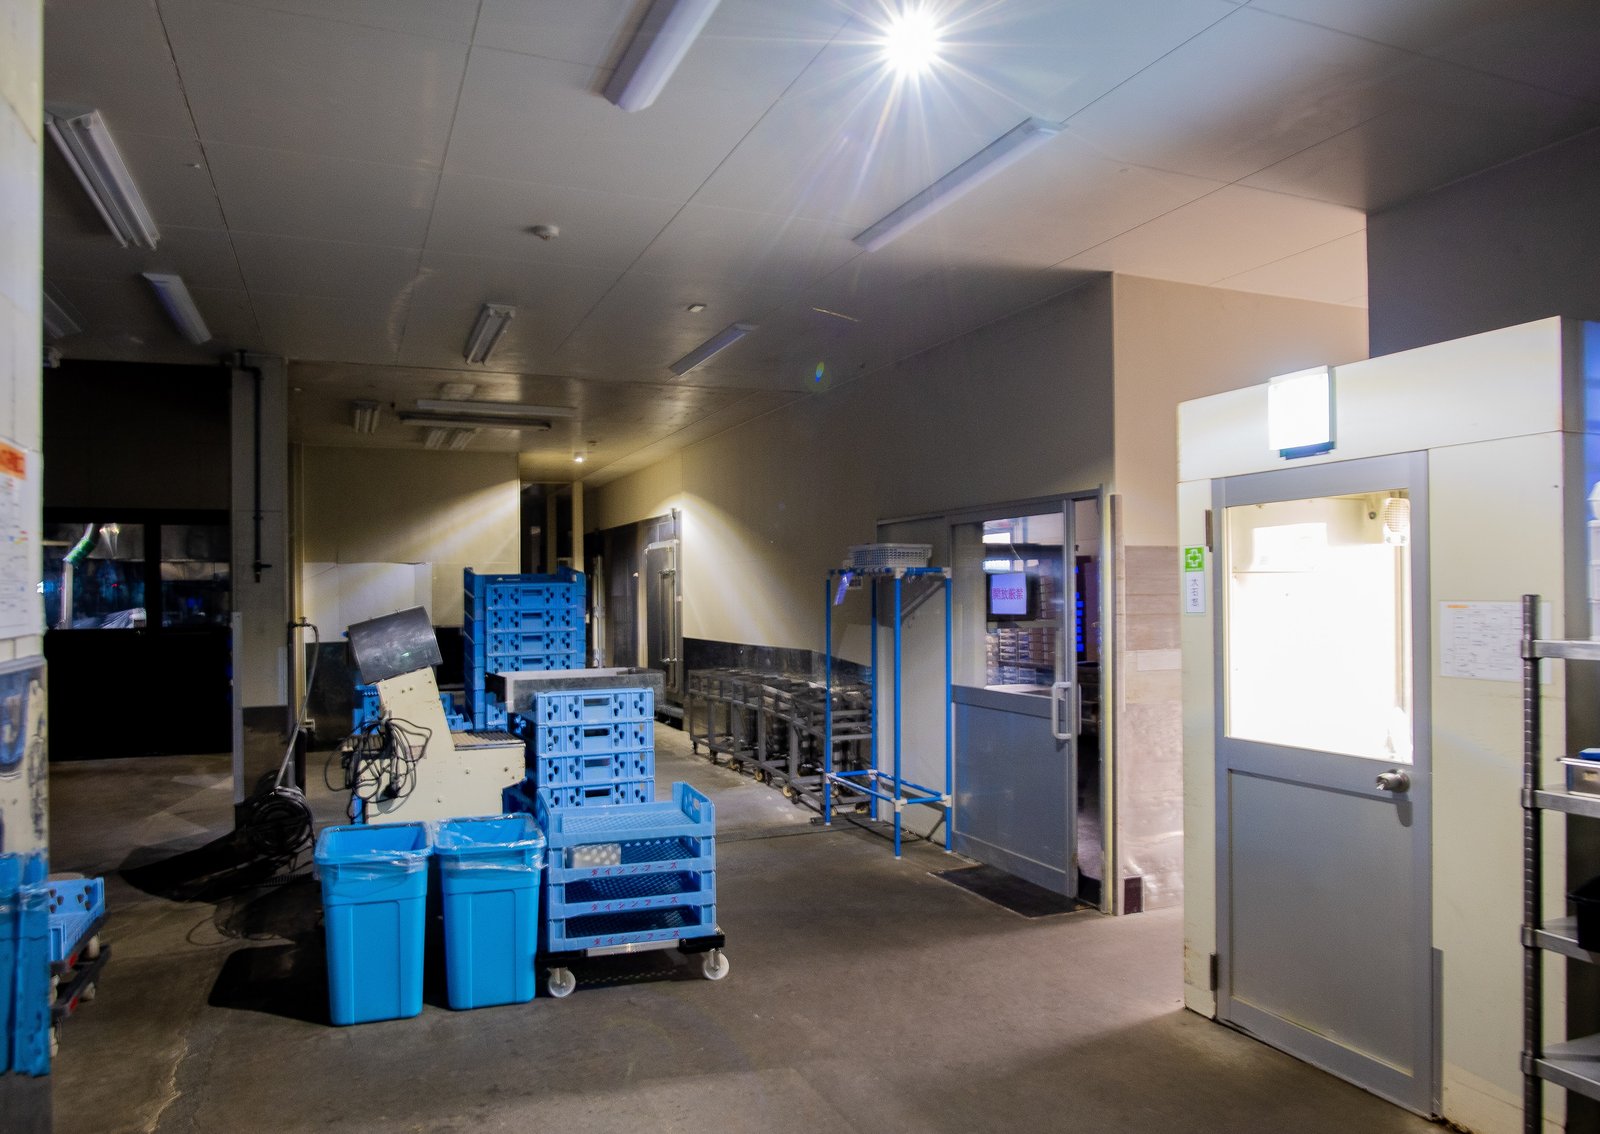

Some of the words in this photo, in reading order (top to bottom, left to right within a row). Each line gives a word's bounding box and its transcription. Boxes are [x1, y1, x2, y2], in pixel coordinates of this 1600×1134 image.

[592, 862, 678, 876] ダイシンフーズ
[592, 897, 678, 912] ダイシンフーズ
[594, 930, 680, 945] ダイシンフーズ
